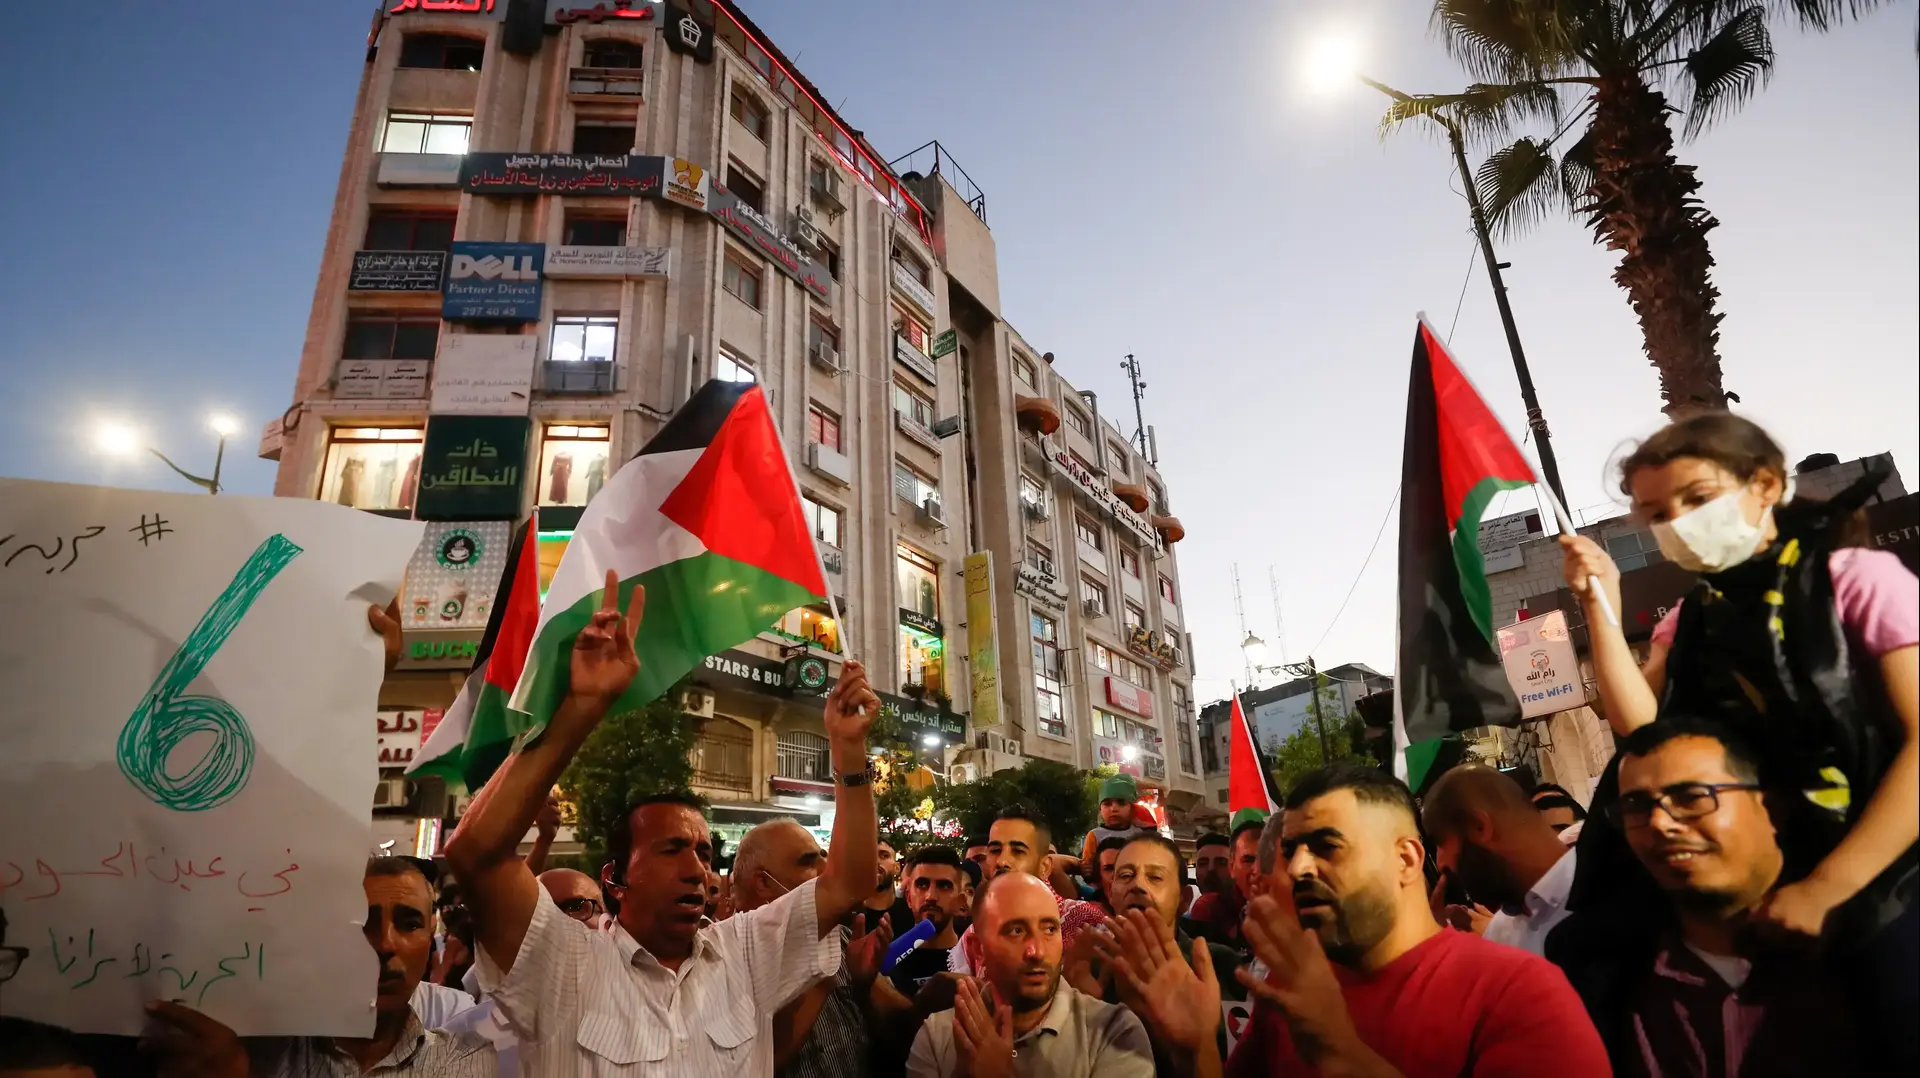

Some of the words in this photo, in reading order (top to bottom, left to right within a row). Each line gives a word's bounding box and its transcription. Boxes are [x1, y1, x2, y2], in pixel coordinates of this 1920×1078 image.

[735, 200, 780, 239] الدكتور
[450, 254, 538, 280] DELL
[448, 283, 495, 294] Partner
[497, 283, 536, 295] Direct
[462, 306, 483, 316] 297
[447, 438, 498, 457] ذات
[421, 464, 517, 490] النطاقين
[129, 513, 174, 547] #
[117, 533, 304, 812] 6
[705, 655, 750, 679] STARS
[751, 667, 761, 682] &
[764, 670, 785, 687] BU
[1526, 670, 1541, 681] الله
[1543, 667, 1556, 680] رام
[1521, 691, 1545, 704] Free
[1545, 682, 1574, 698] Wi-Fi
[902, 711, 927, 728] باكس
[146, 847, 226, 892] عين
[238, 848, 300, 912] في
